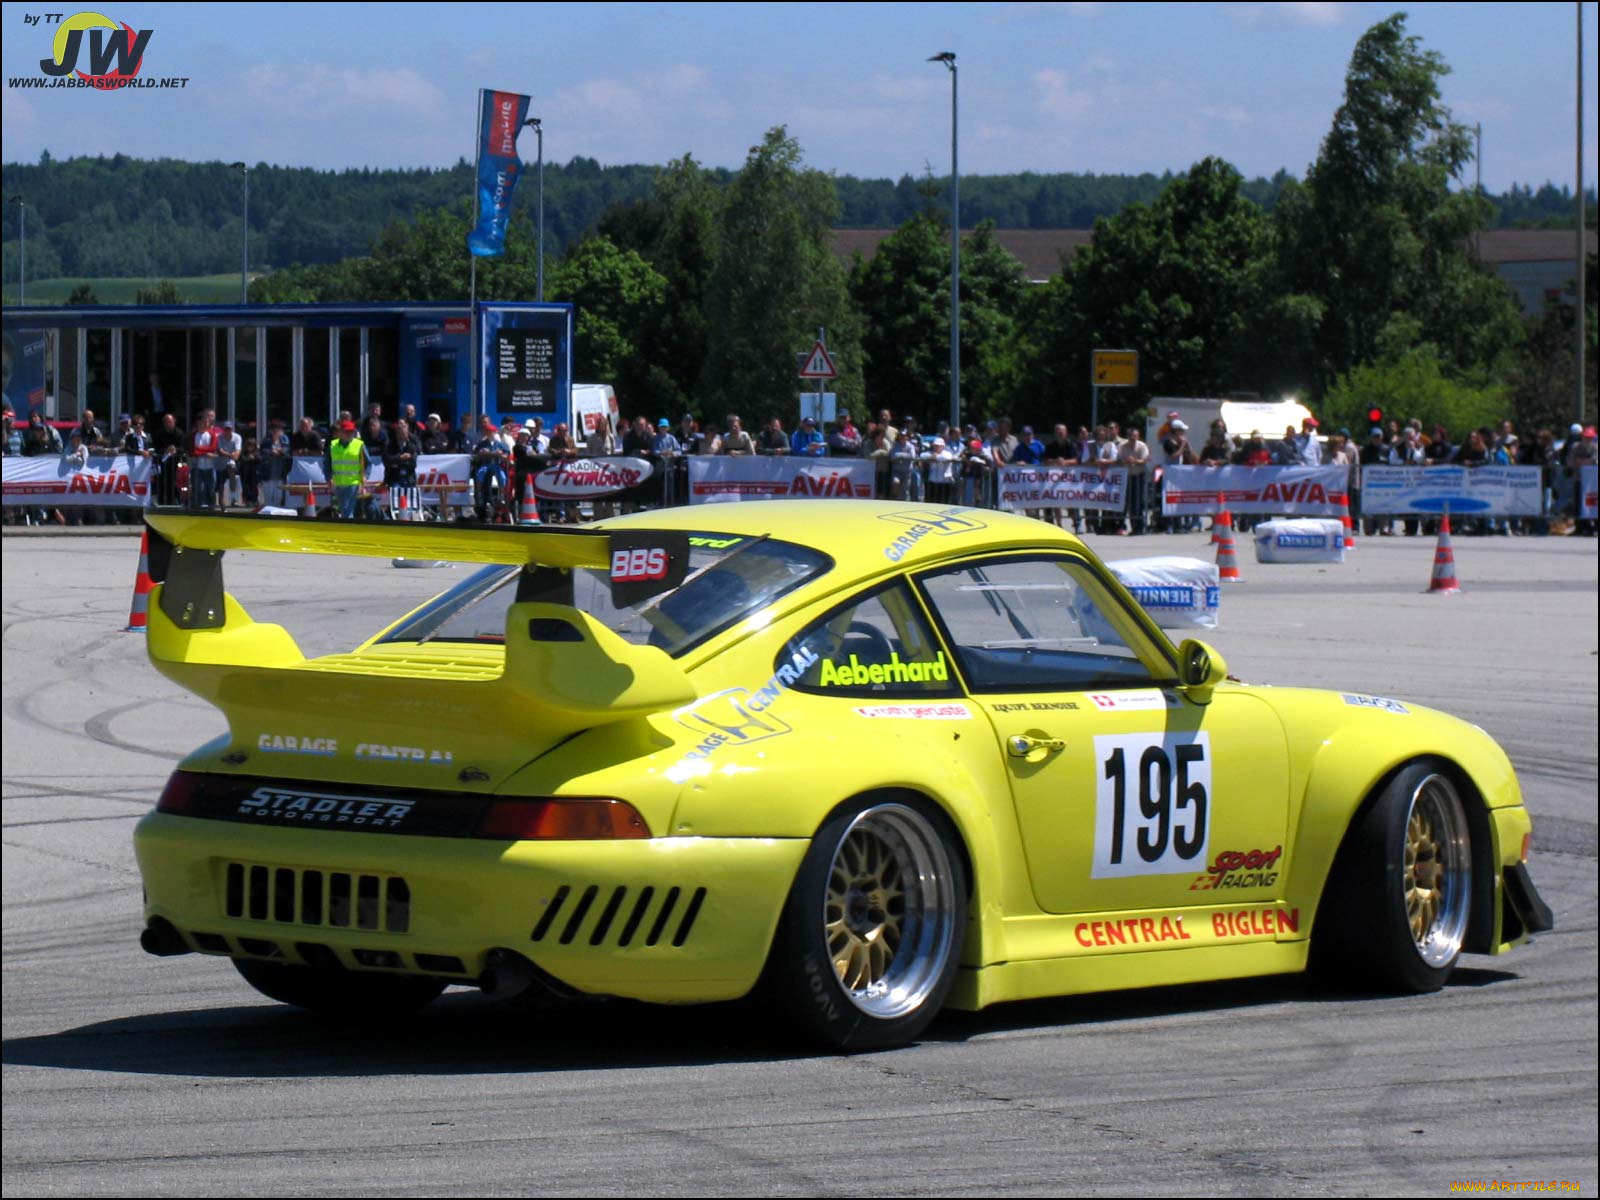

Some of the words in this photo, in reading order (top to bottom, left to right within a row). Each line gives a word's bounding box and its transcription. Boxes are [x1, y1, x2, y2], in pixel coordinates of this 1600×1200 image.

[569, 462, 601, 471] RADIO
[1002, 490, 1040, 502] REVUE
[1043, 489, 1121, 504] AUTOMOBILE
[884, 523, 933, 562] GARAGE
[611, 548, 668, 582] BBS
[747, 646, 820, 712] CENTRAL
[819, 650, 949, 687] Aeberhard
[991, 702, 1031, 713] EQUIPE
[257, 733, 338, 757] GARAGE
[354, 743, 454, 765] CENTRAL
[237, 805, 403, 827] MOTORSPORT
[241, 787, 416, 819] STADLER
[1104, 743, 1208, 865] 195
[1220, 871, 1280, 889] RACING
[1074, 915, 1191, 948] CENTRAL
[1211, 907, 1300, 938] BIGLEN
